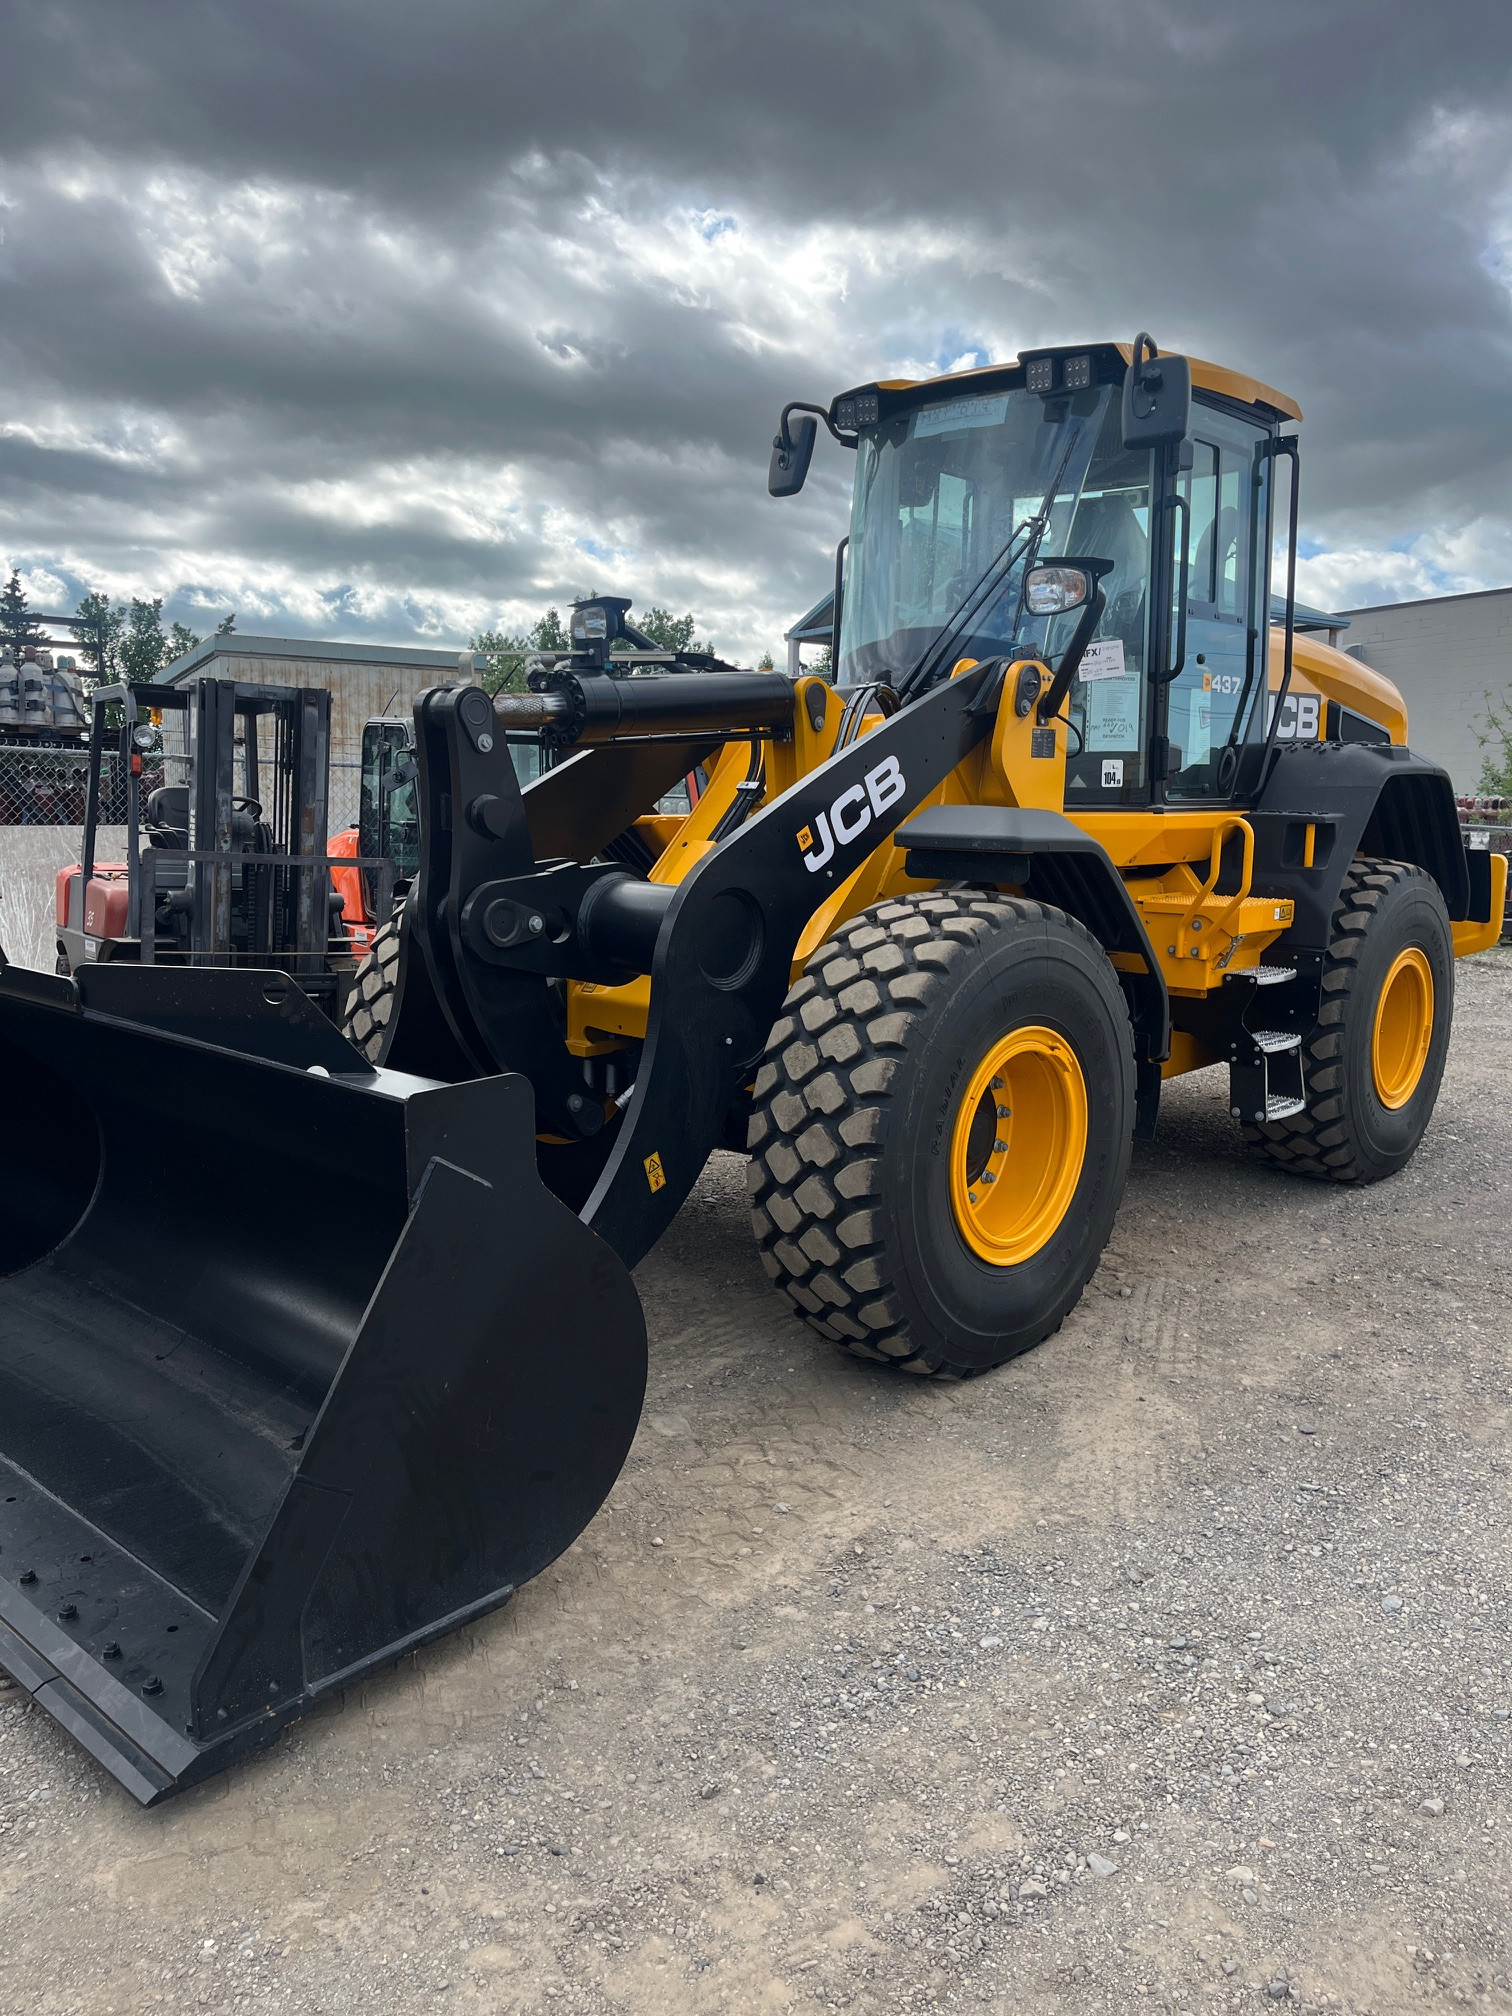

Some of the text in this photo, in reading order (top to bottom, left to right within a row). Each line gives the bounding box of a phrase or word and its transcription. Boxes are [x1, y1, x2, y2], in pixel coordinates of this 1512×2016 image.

[1211, 674, 1241, 695] 437
[1104, 771, 1116, 785] 104
[804, 755, 906, 873] JCB
